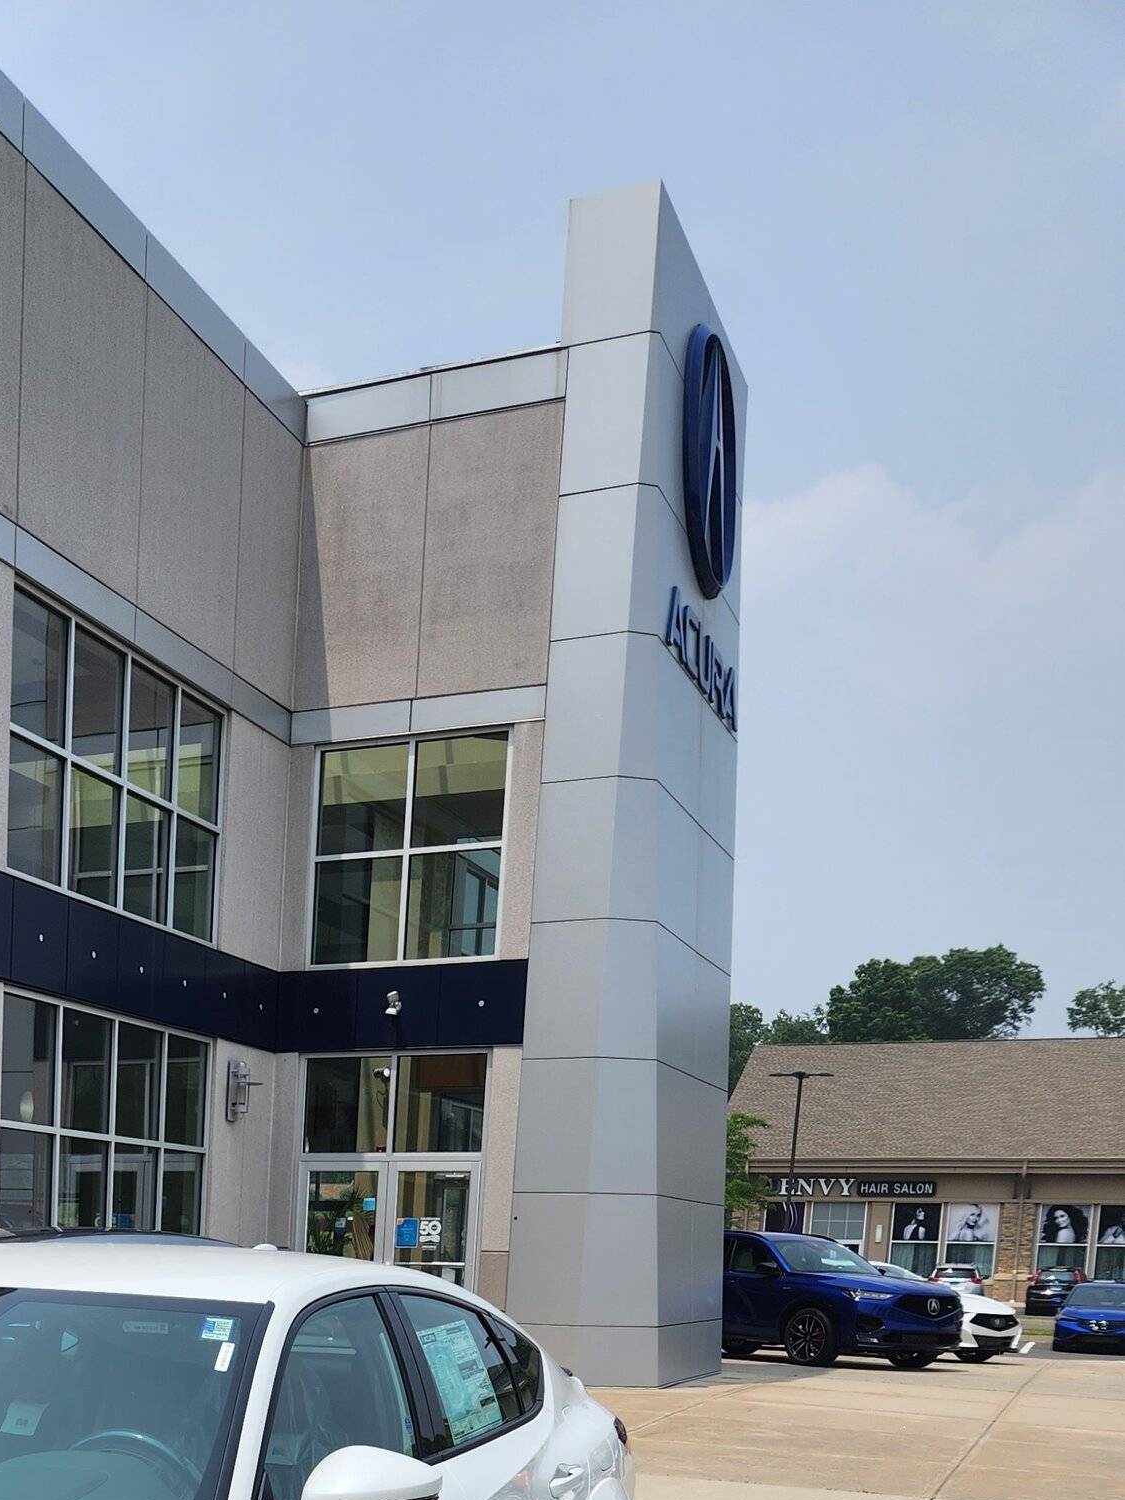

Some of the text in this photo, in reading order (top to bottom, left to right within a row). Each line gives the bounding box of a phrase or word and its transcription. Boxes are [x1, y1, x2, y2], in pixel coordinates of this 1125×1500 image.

[665, 585, 737, 733] ACURA
[778, 1178, 934, 1196] ENVY HAIR SALON
